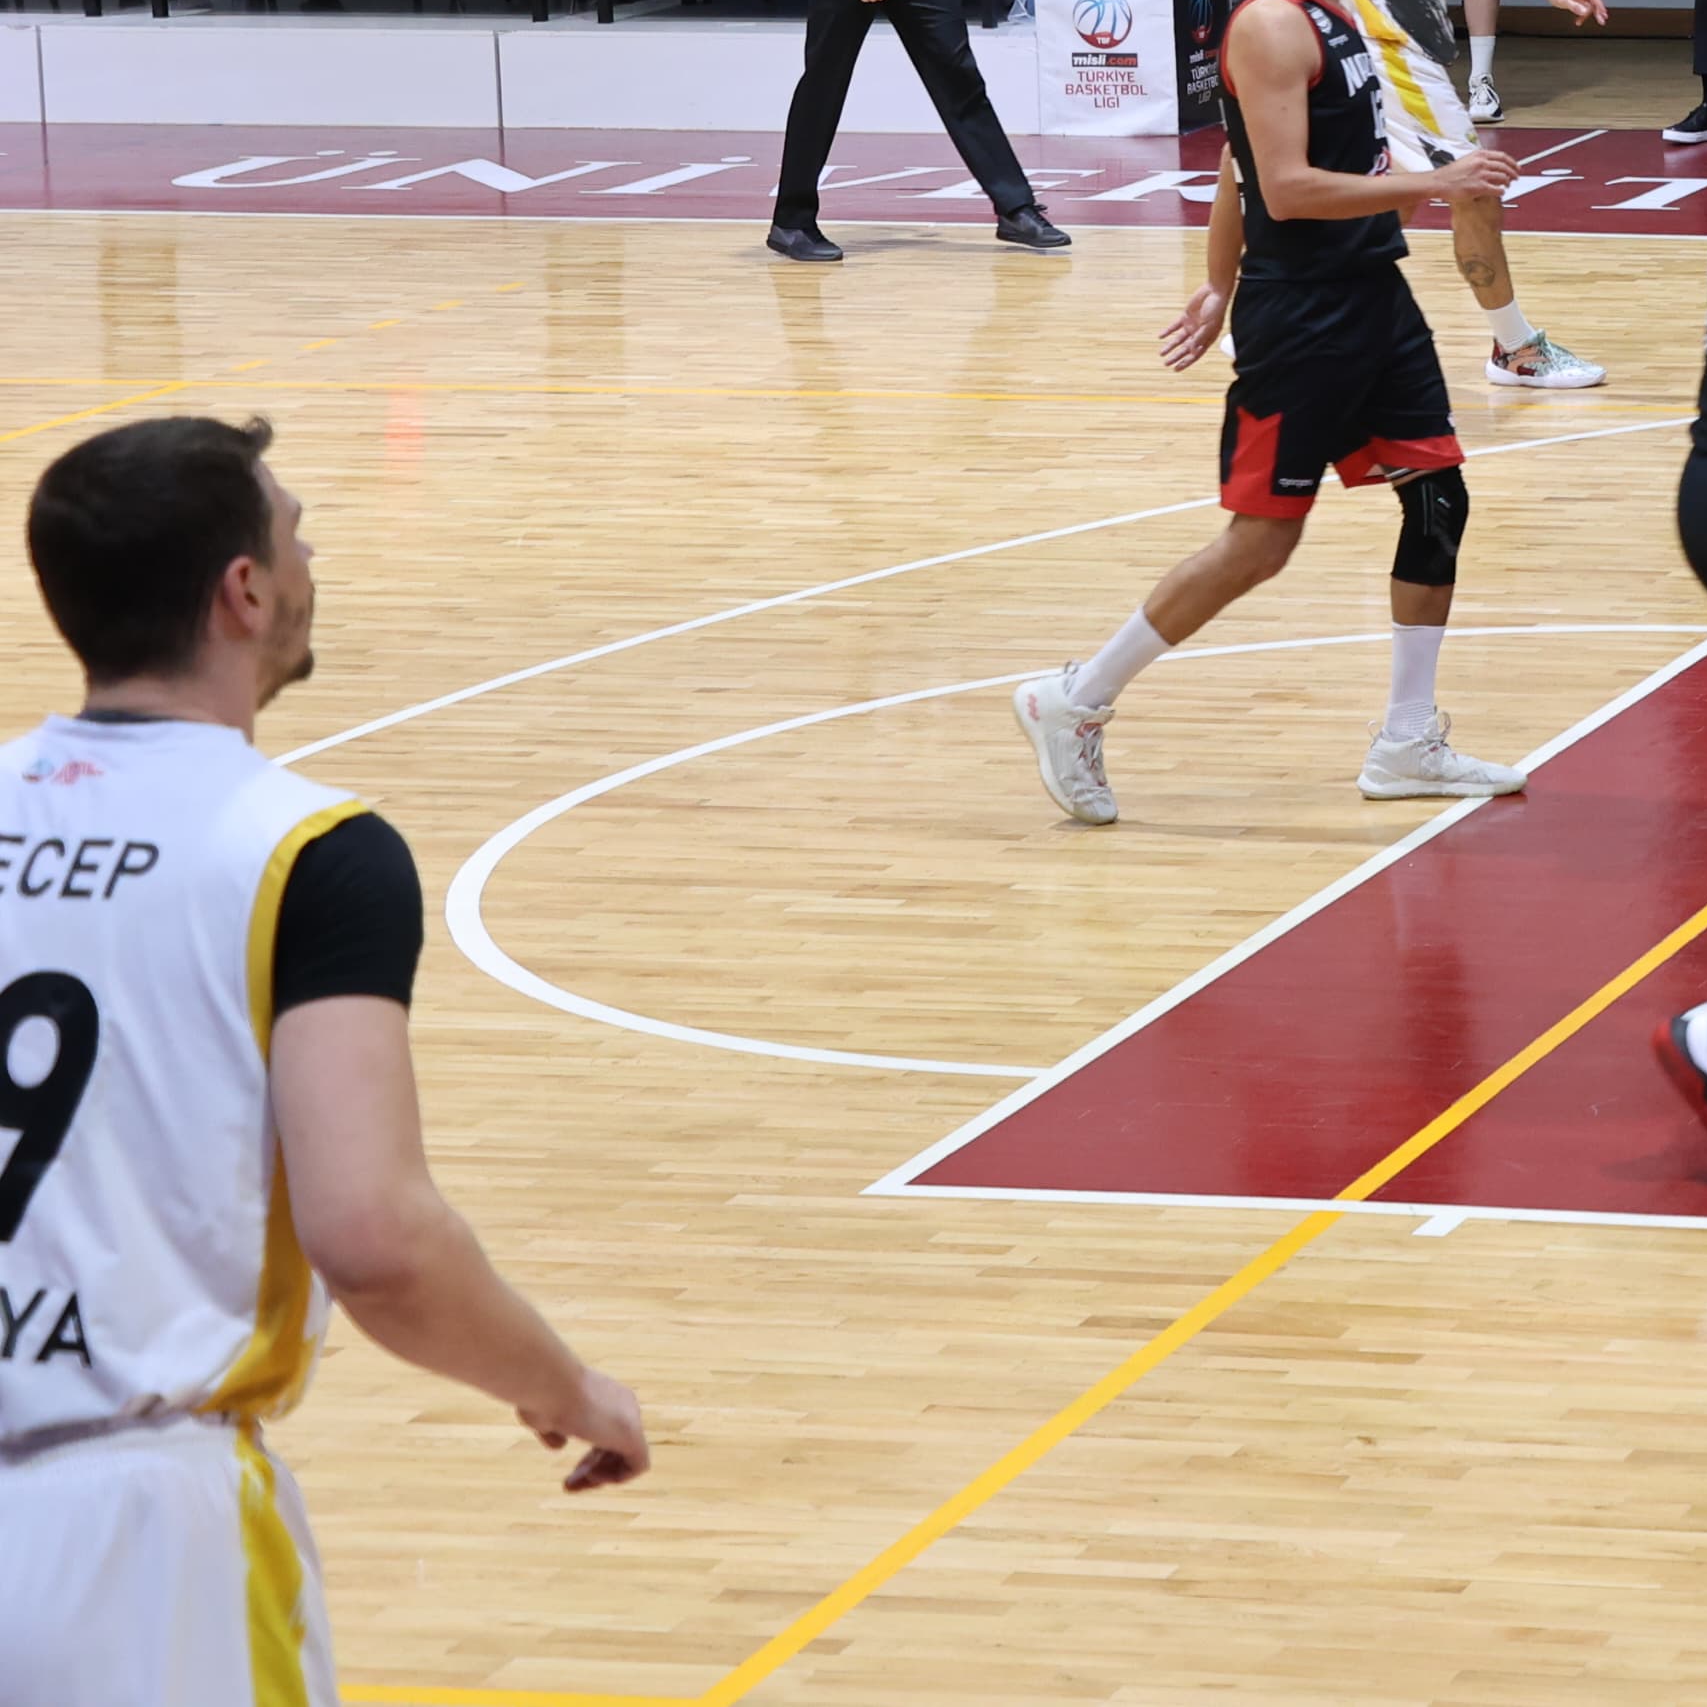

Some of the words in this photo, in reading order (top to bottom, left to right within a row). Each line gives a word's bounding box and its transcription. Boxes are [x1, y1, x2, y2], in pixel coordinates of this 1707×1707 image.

[1077, 70, 1135, 83] TÜRKİYE
[1065, 83, 1148, 96] BASKETBOL
[1094, 95, 1120, 109] LİGİ
